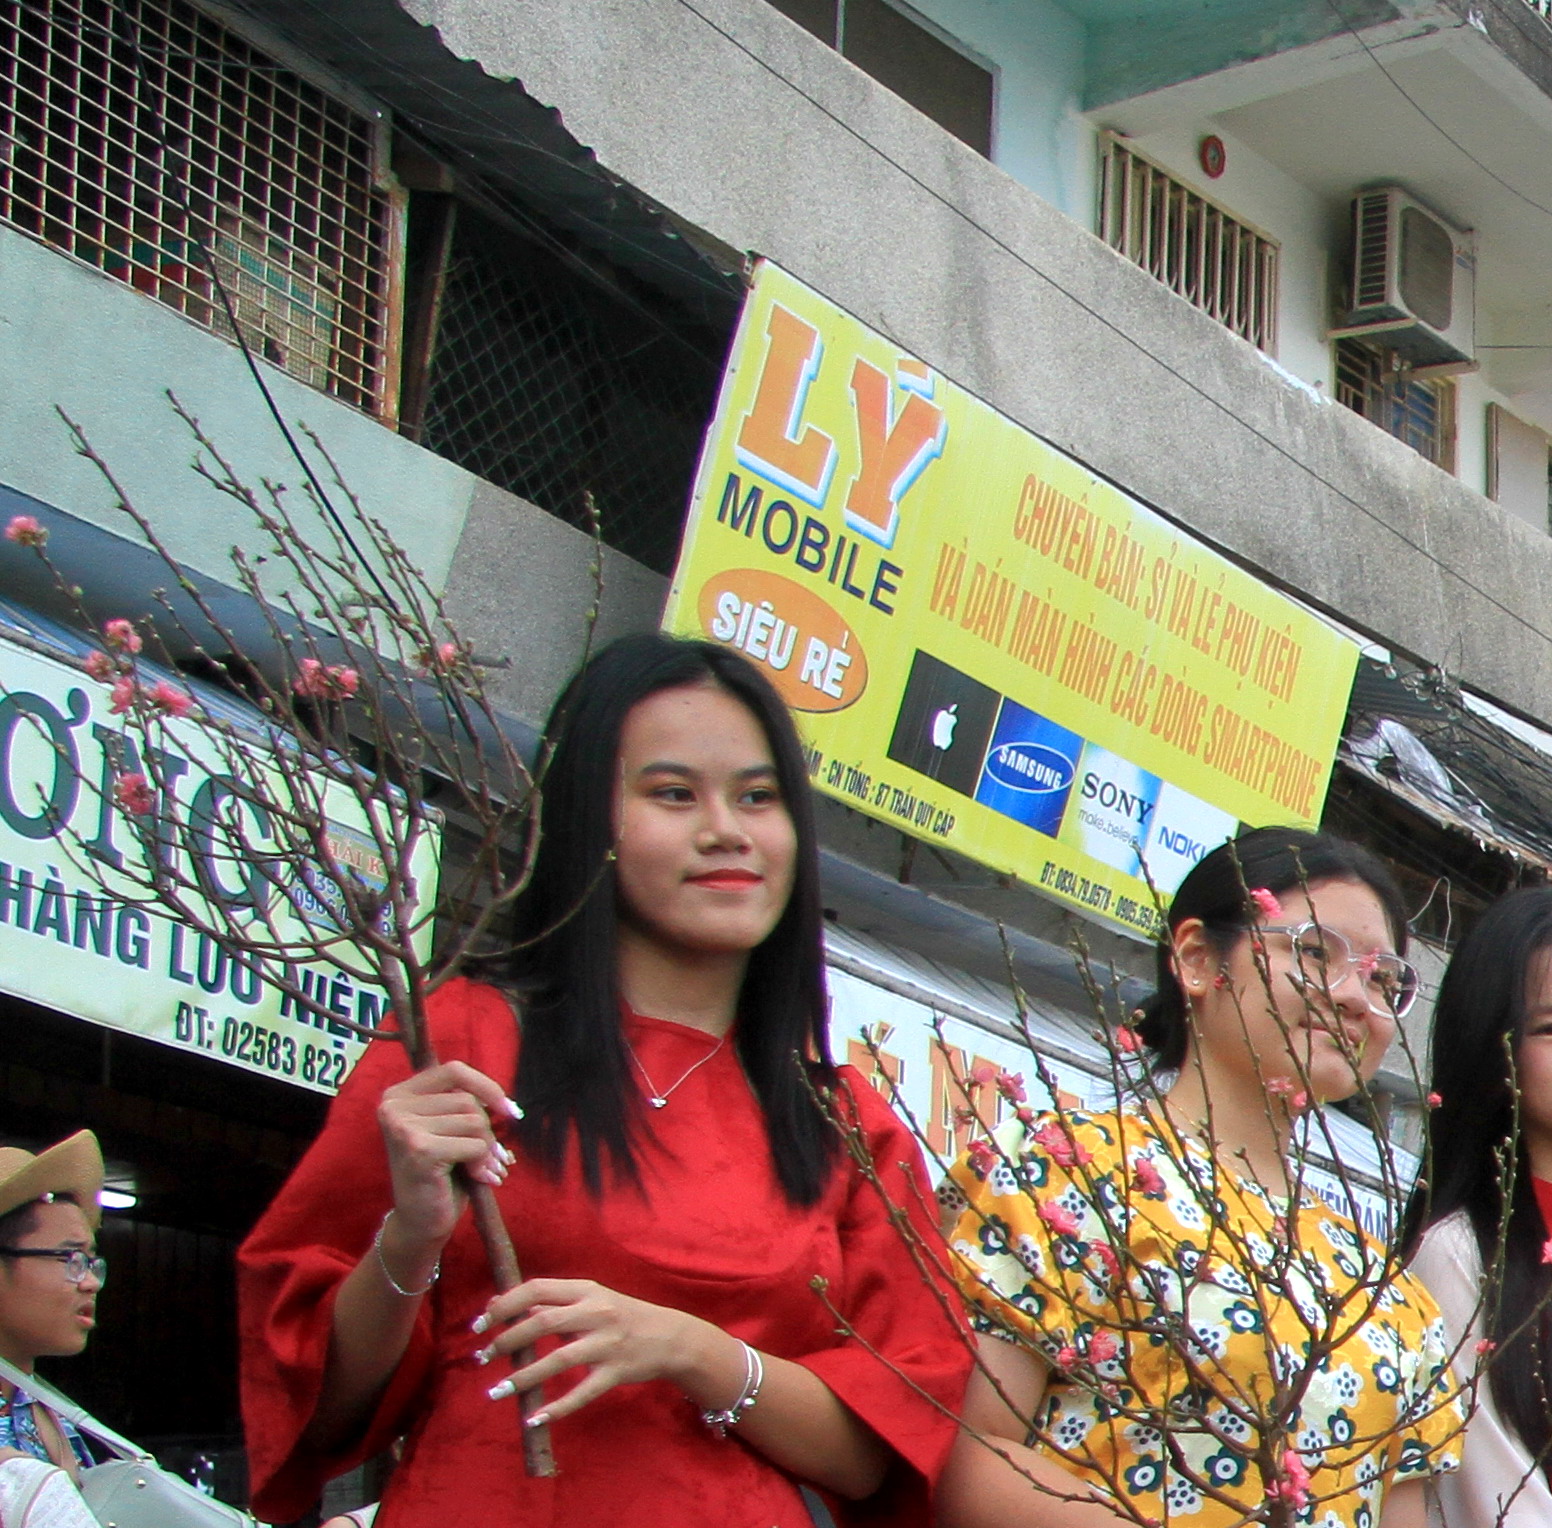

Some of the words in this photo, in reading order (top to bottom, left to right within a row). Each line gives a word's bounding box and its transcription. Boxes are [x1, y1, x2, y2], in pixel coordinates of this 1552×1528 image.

[717, 472, 904, 616] MOBILE
[1013, 473, 1101, 581] CHUYÊN
[1167, 563, 1198, 641] VÀ
[1215, 602, 1260, 691] PHỤ
[1254, 624, 1302, 710] KIỆN
[712, 591, 798, 671] SIÊU
[800, 630, 852, 699] RẺ
[929, 537, 968, 622] VÀ
[960, 558, 1016, 648] DÁN
[1007, 587, 1067, 677] MÀN
[1057, 611, 1118, 706] HÌNH
[1110, 645, 1157, 727] CÁC
[1150, 665, 1208, 757] DÒNG
[1203, 703, 1323, 819] SMARTPHONE
[998, 746, 1063, 788] SAMSUNG
[1080, 771, 1154, 825] SONY
[223, 1017, 296, 1076] 02583
